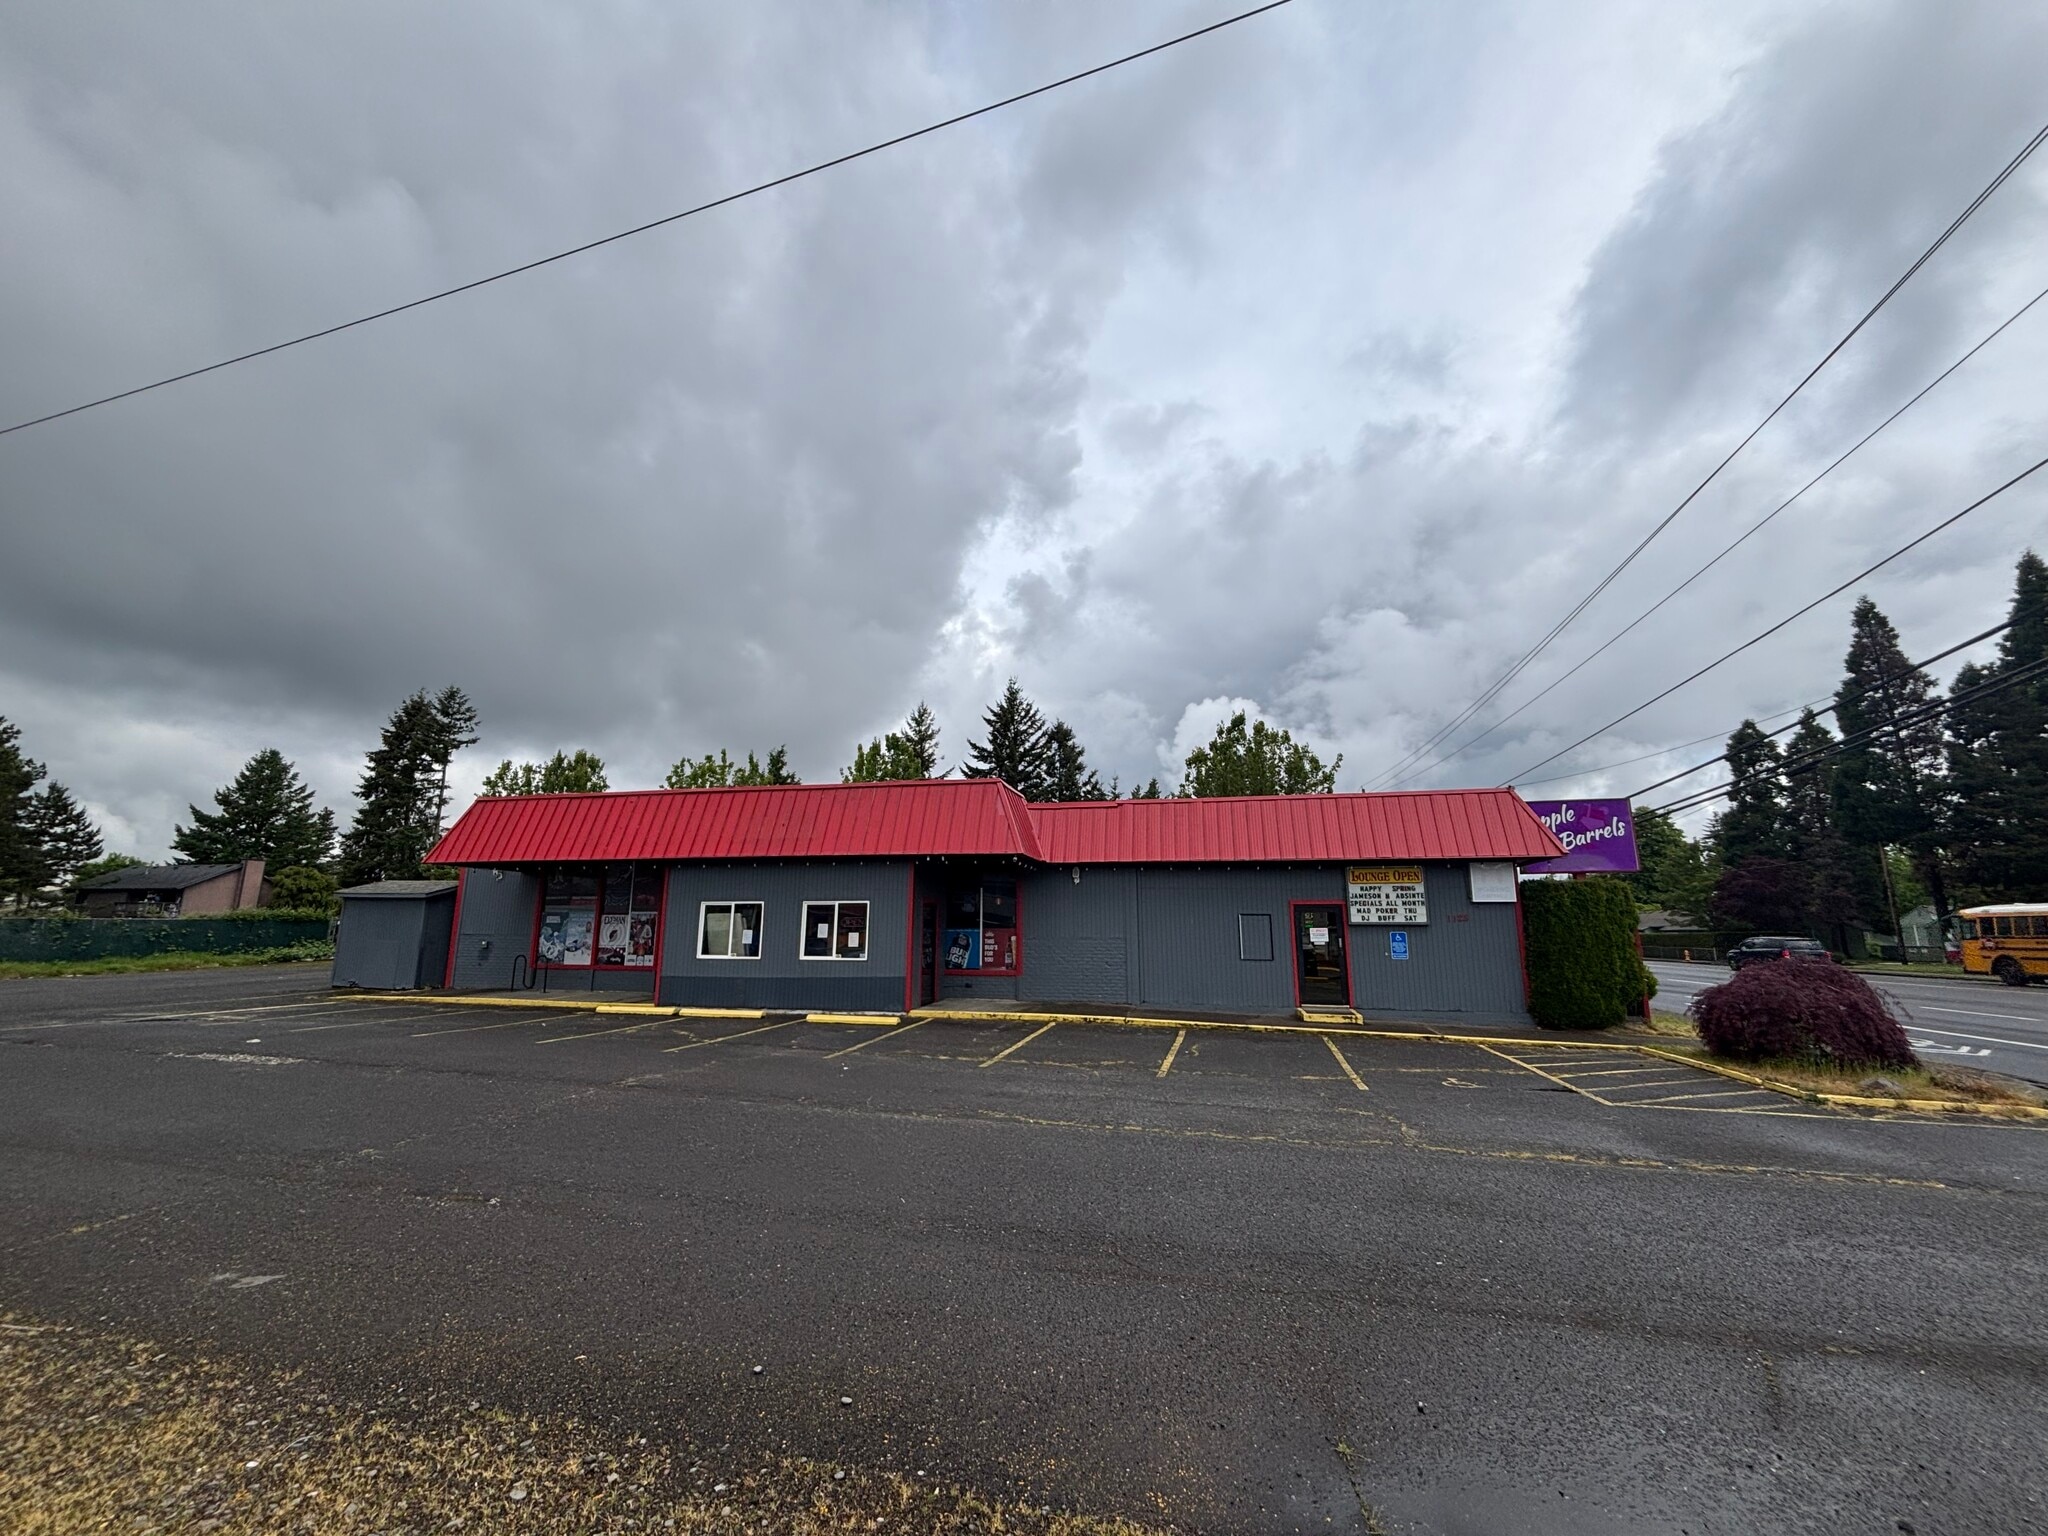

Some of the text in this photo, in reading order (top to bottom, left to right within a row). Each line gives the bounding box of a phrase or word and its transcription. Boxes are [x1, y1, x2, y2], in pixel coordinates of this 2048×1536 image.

[1540, 803, 1576, 834] pple
[1558, 816, 1626, 851] Barrels
[1350, 870, 1420, 882] LOUNGE OPEN
[1350, 892, 1382, 900] JAMESON
[950, 946, 968, 958] BUD
